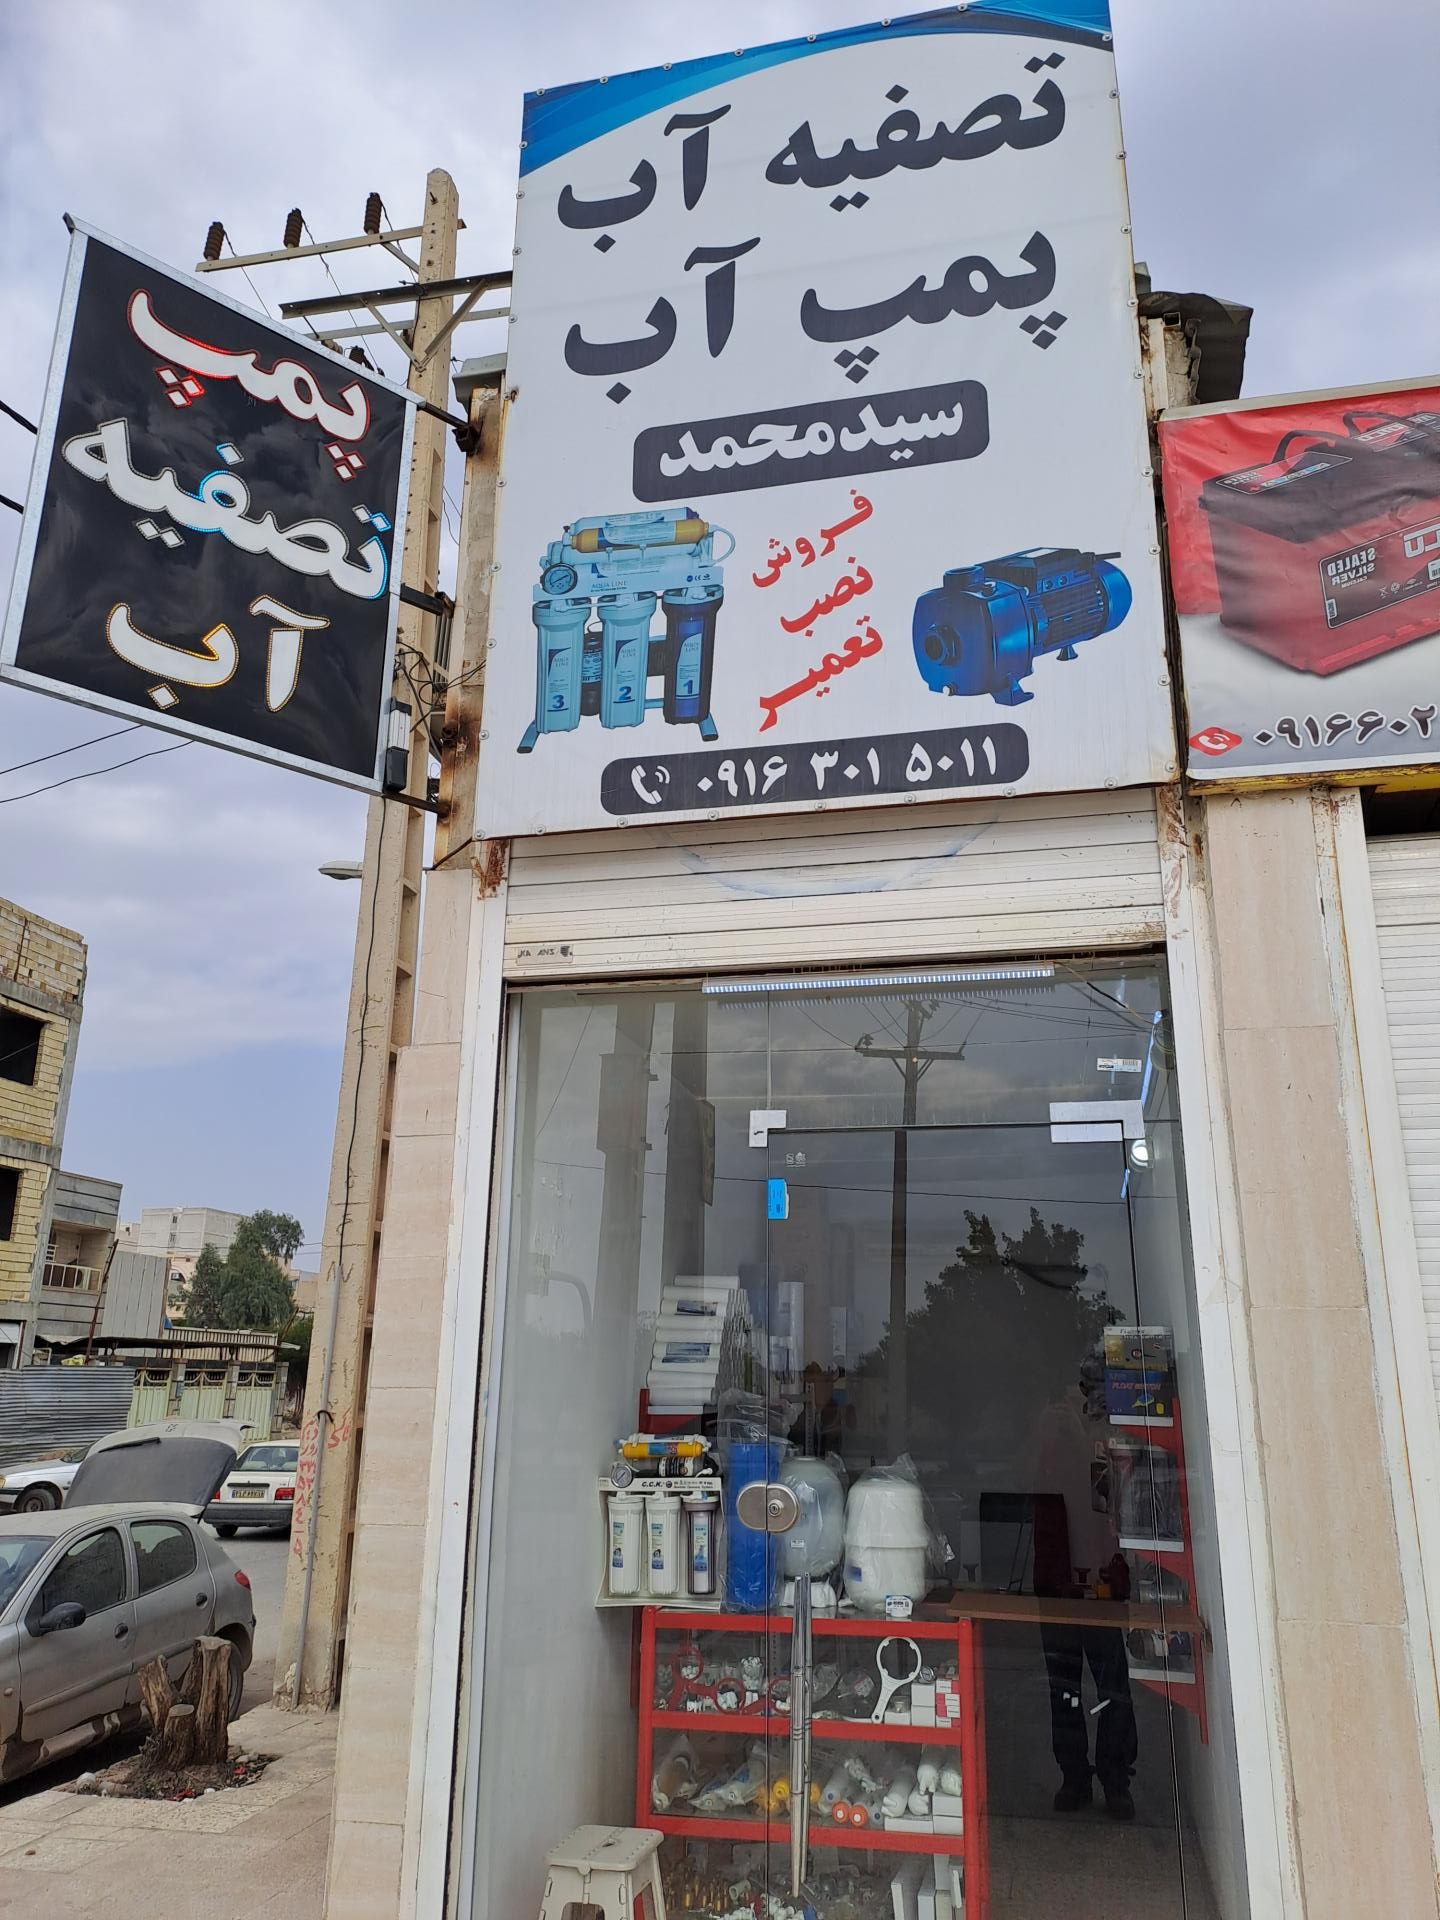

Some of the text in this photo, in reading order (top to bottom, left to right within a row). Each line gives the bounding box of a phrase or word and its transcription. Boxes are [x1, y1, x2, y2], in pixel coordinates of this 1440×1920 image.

[557, 52, 1066, 253] تصفیه آب
[564, 230, 1067, 403] پمپ آب
[127, 289, 371, 481] پمپ
[61, 417, 391, 599] تصفیه
[752, 489, 873, 588] فروش
[780, 557, 873, 637] نصب
[106, 595, 330, 712] آب
[552, 694, 565, 709] 3
[618, 686, 632, 701] 2
[683, 679, 694, 695] 1
[759, 615, 883, 732] تعمیر
[697, 735, 998, 797] ۰۹۱۶ ۳۰۱ ۵۰۱۱
